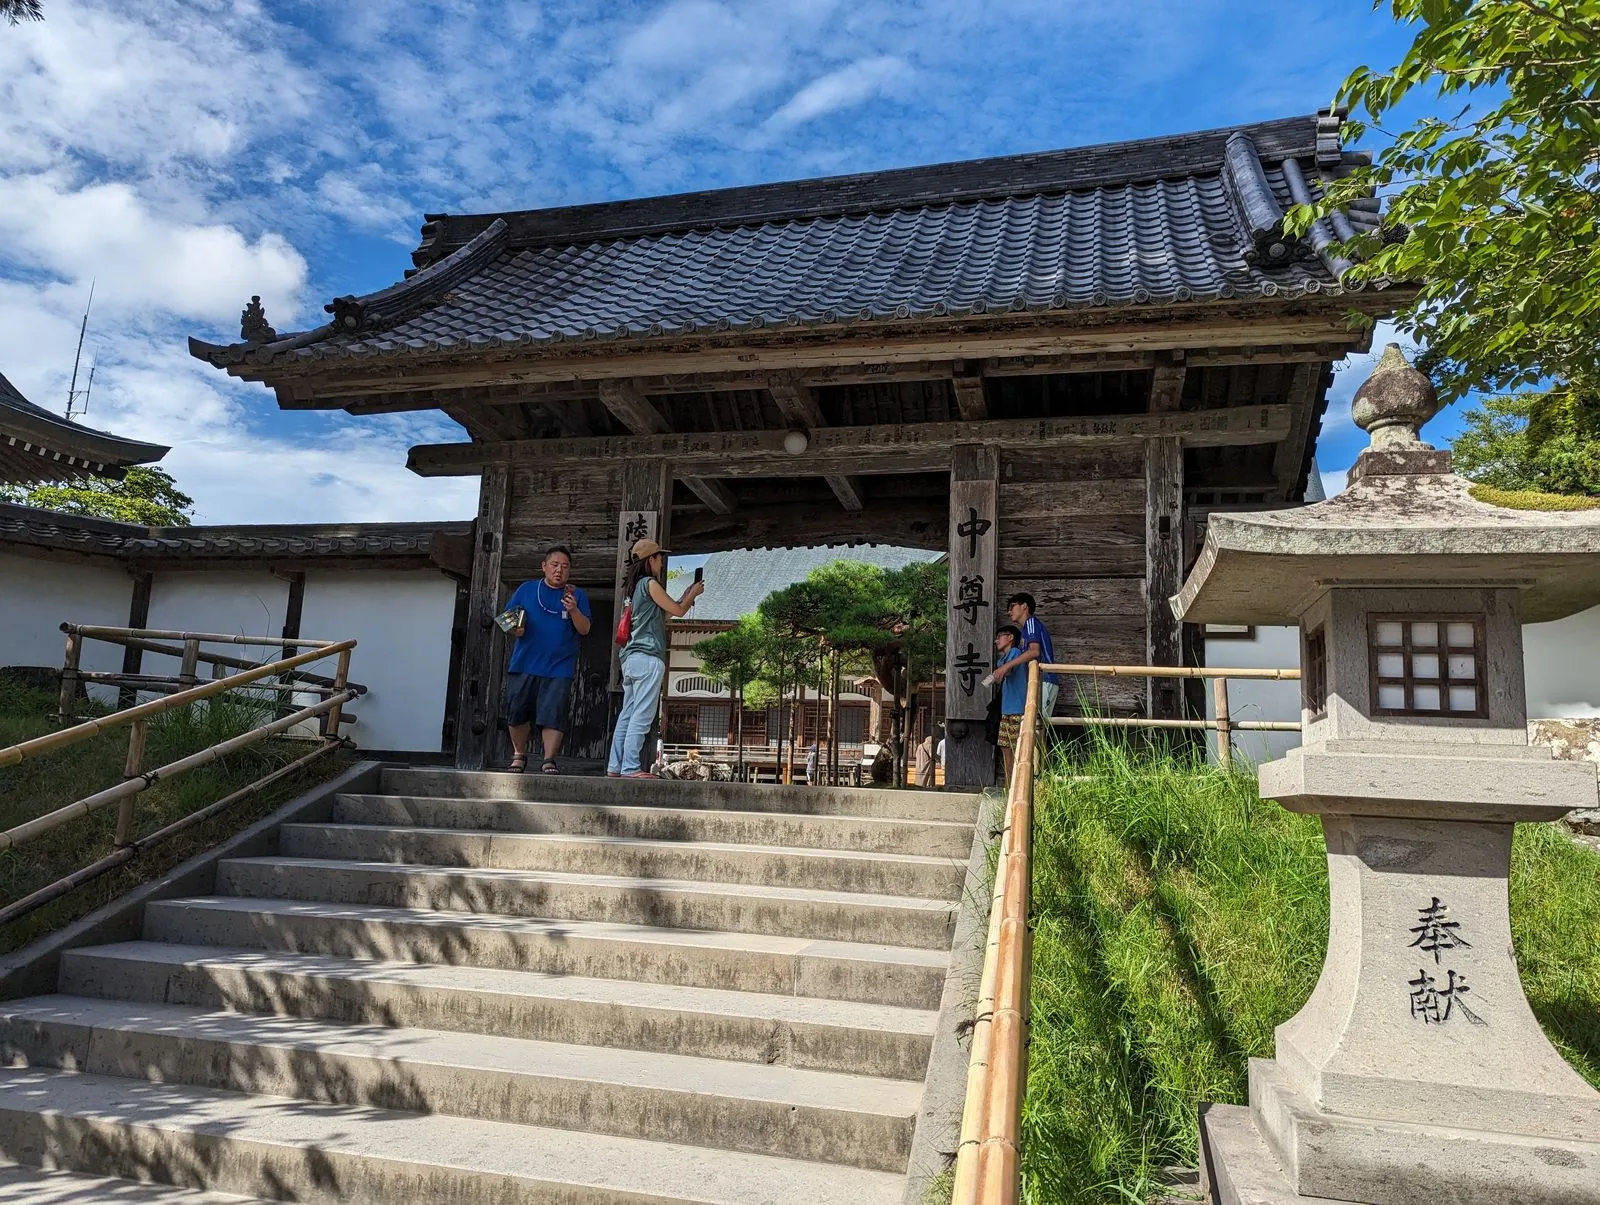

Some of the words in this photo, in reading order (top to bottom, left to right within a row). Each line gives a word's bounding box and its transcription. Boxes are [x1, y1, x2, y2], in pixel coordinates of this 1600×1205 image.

[954, 508, 991, 697] 中尊寺
[1407, 896, 1488, 1026] 奉献
